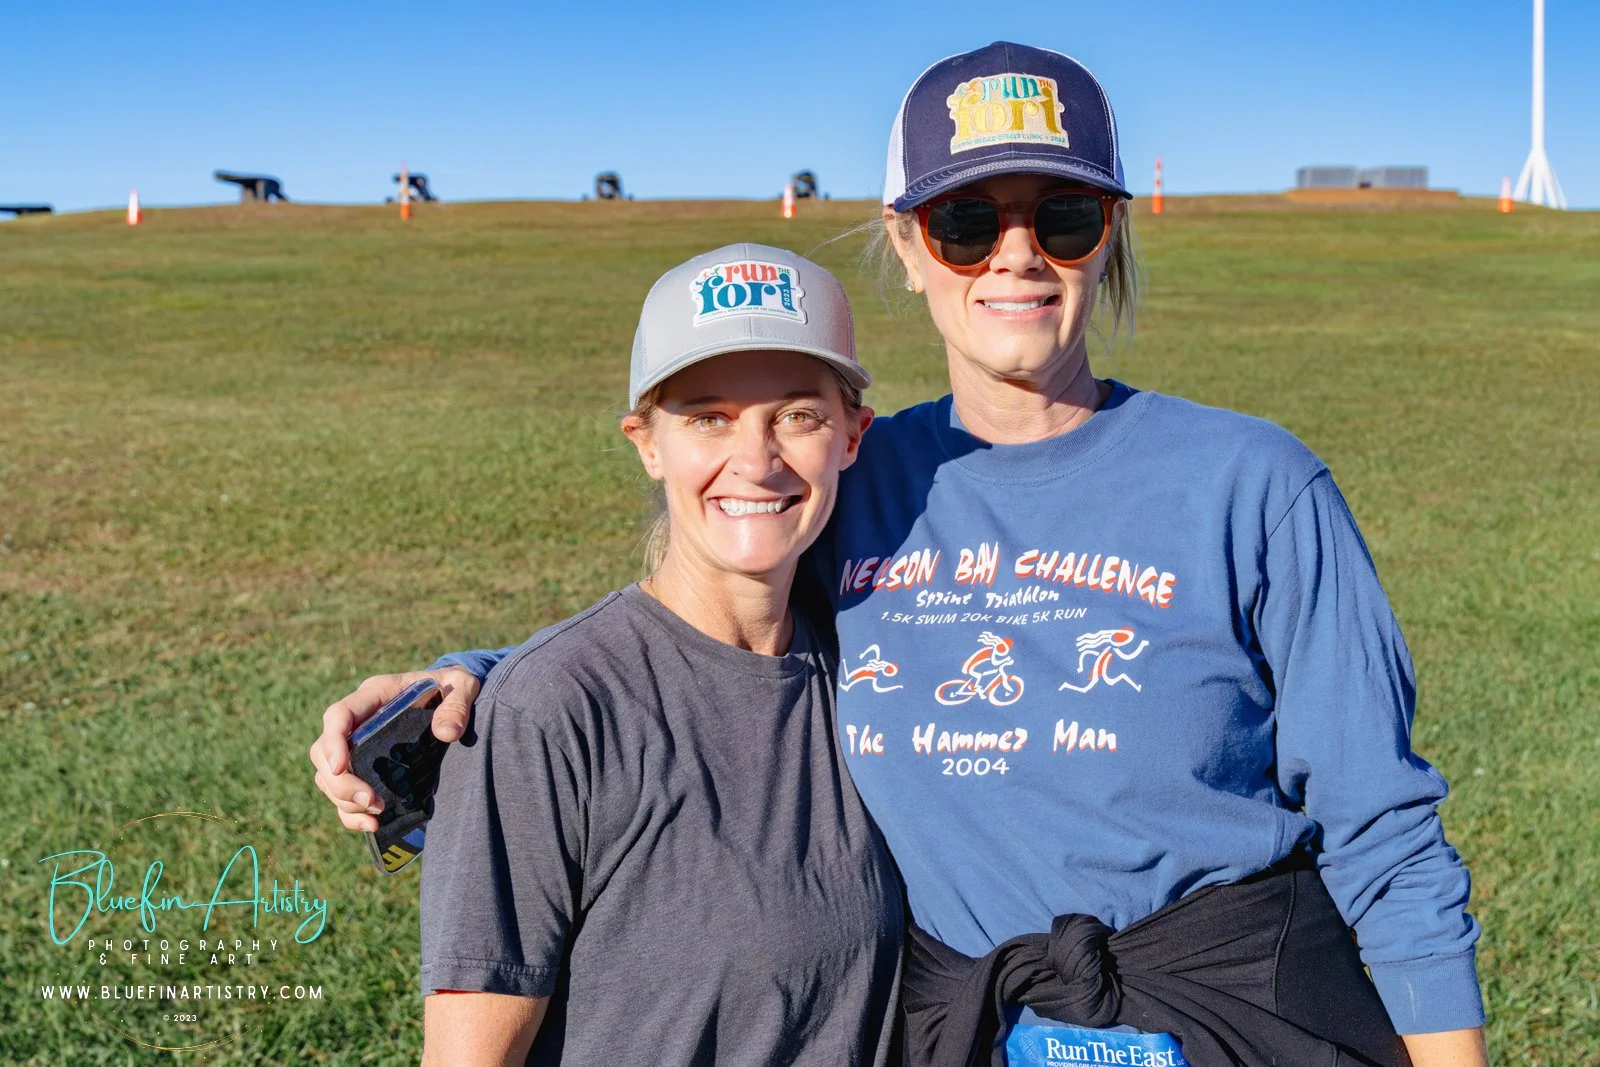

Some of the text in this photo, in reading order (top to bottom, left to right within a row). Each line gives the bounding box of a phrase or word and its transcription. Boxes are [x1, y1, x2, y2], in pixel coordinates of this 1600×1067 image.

[981, 76, 1053, 101] run THE
[954, 87, 1062, 140] fort
[724, 264, 791, 283] run THE
[699, 273, 797, 315] fort
[840, 541, 1176, 608] NELSON BAY CHALLENGE
[986, 586, 1059, 608] Triathlon
[881, 607, 1087, 625] 1.5K SWIM 20K BIKE 5K RUN
[846, 718, 1117, 756] The Hammer Man
[942, 757, 1010, 777] 2004
